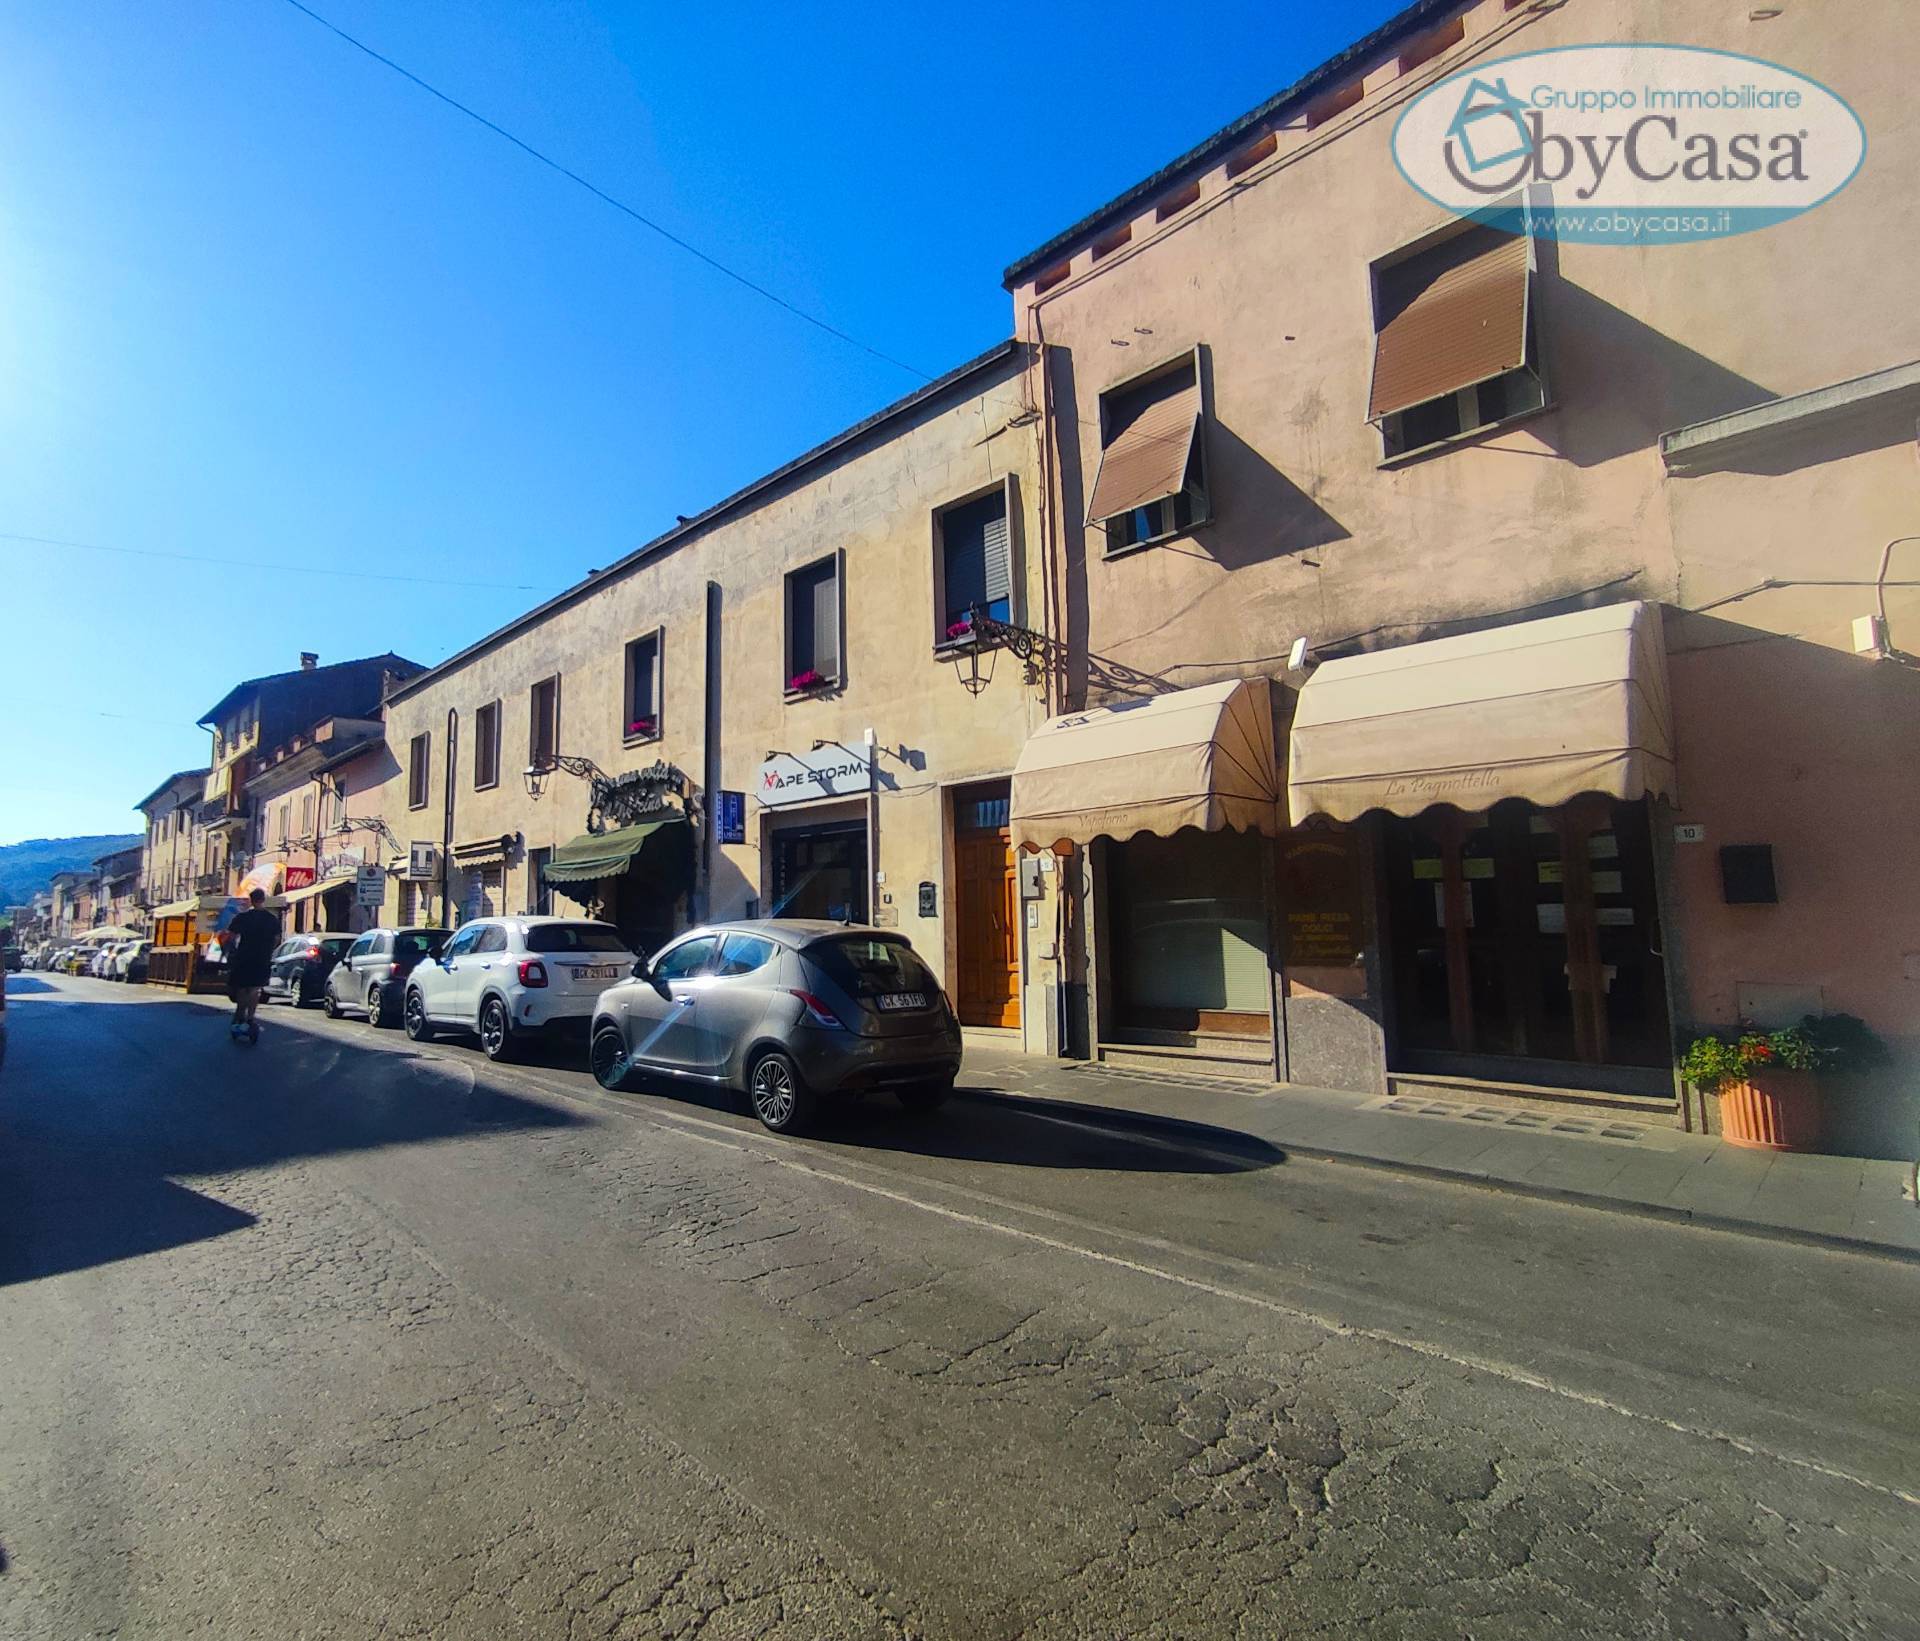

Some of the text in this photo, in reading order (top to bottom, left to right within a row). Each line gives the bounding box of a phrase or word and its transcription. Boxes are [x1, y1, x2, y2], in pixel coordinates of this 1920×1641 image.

[764, 762, 863, 791] VAPE STORM
[1384, 780, 1405, 796] La
[1683, 828, 1696, 839] 10
